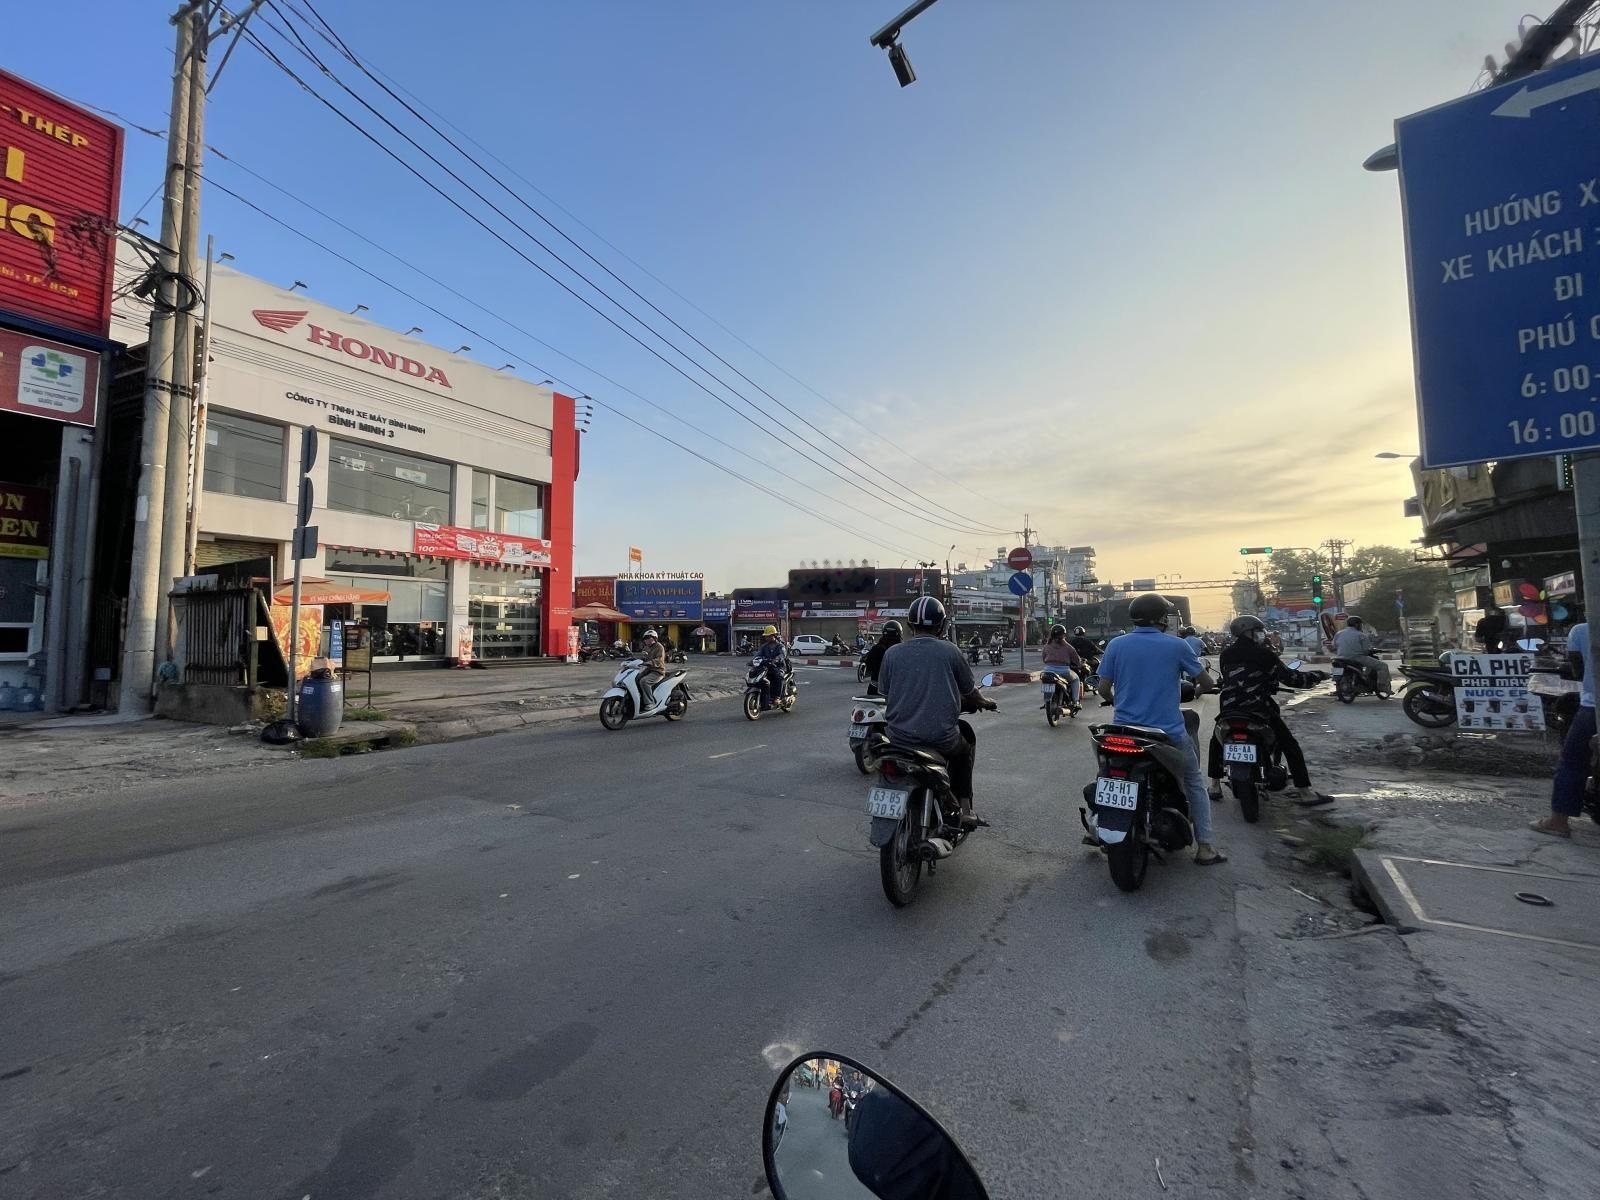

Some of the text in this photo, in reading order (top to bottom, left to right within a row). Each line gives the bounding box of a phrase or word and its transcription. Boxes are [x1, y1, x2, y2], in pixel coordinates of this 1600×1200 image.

[17, 107, 89, 148] THÉP
[1464, 190, 1562, 237] HƯỚNG
[1440, 254, 1474, 284] XE
[1487, 227, 1583, 273] KHÁCH
[1554, 272, 1583, 301] ĐI
[1518, 312, 1576, 354] PHÚ
[307, 322, 452, 389] HONDA
[286, 391, 314, 405] CÔNG
[316, 400, 329, 409] TY
[331, 403, 354, 416] TNHH
[356, 411, 368, 419] XE
[328, 414, 395, 438] BÌNH MINH 3
[1507, 410, 1596, 445] 16:00
[634, 572, 654, 580] KHOA
[667, 571, 688, 581] THUẬT
[1454, 656, 1532, 676] CÀ PHÊ
[1461, 678, 1490, 687] PHA
[1098, 791, 1134, 808] 539.05
[1103, 780, 1131, 796] 78-H1
